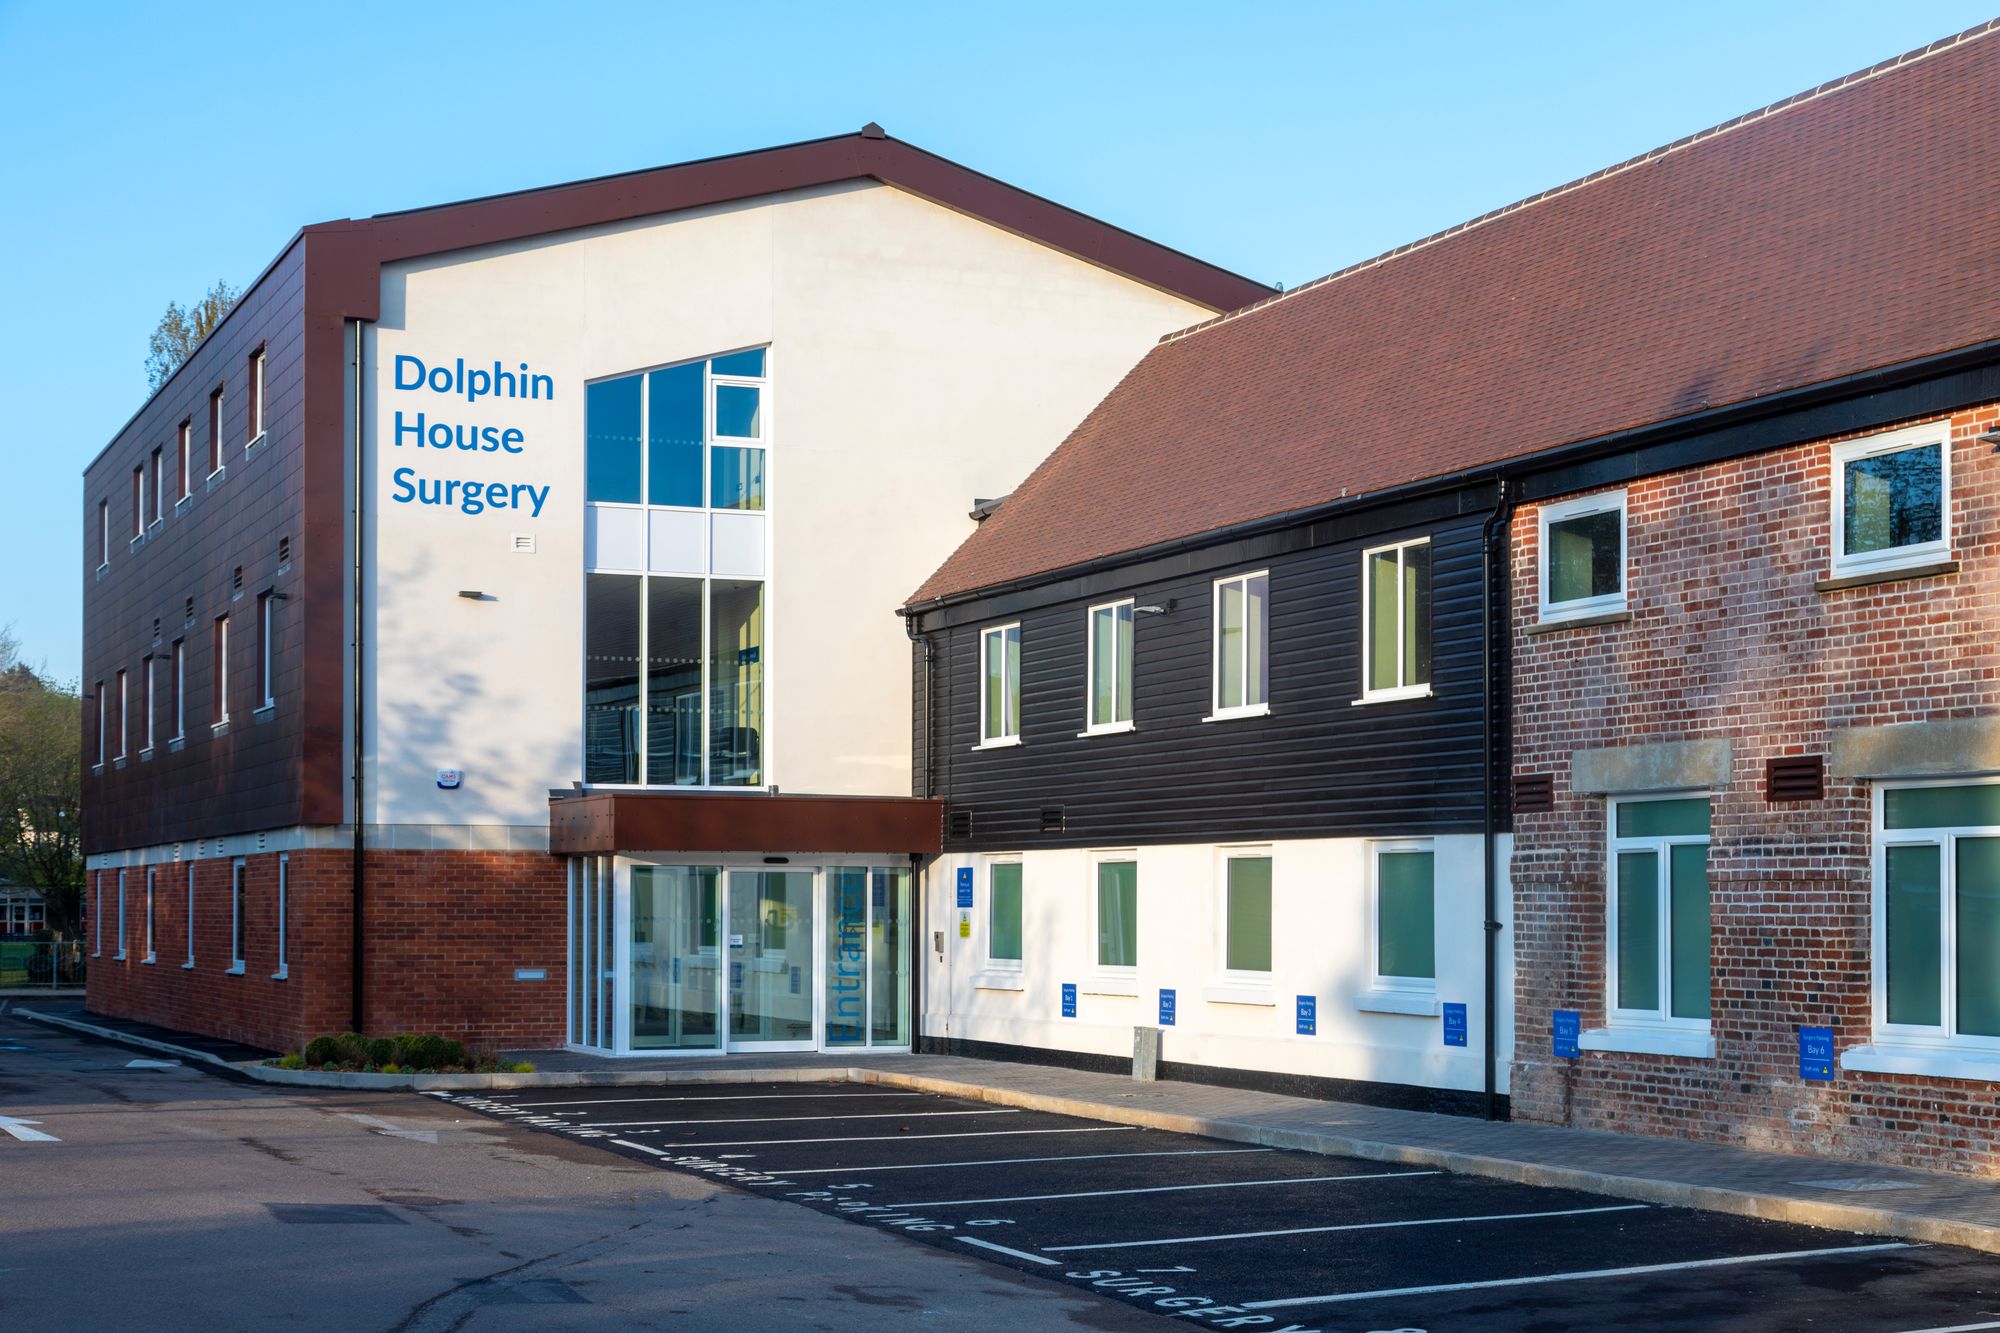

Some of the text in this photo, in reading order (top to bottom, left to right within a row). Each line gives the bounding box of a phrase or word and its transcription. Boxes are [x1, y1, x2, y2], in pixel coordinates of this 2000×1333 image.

[395, 354, 553, 402] Dolphin
[395, 411, 524, 454] House
[392, 467, 550, 517] Surgery
[829, 871, 861, 1041] Entrance
[1560, 1026, 1573, 1036] Bay 5
[1808, 1044, 1825, 1055] Bay 6
[660, 1156, 796, 1186] SURGERY
[1065, 1270, 1321, 1333] SURGERY
